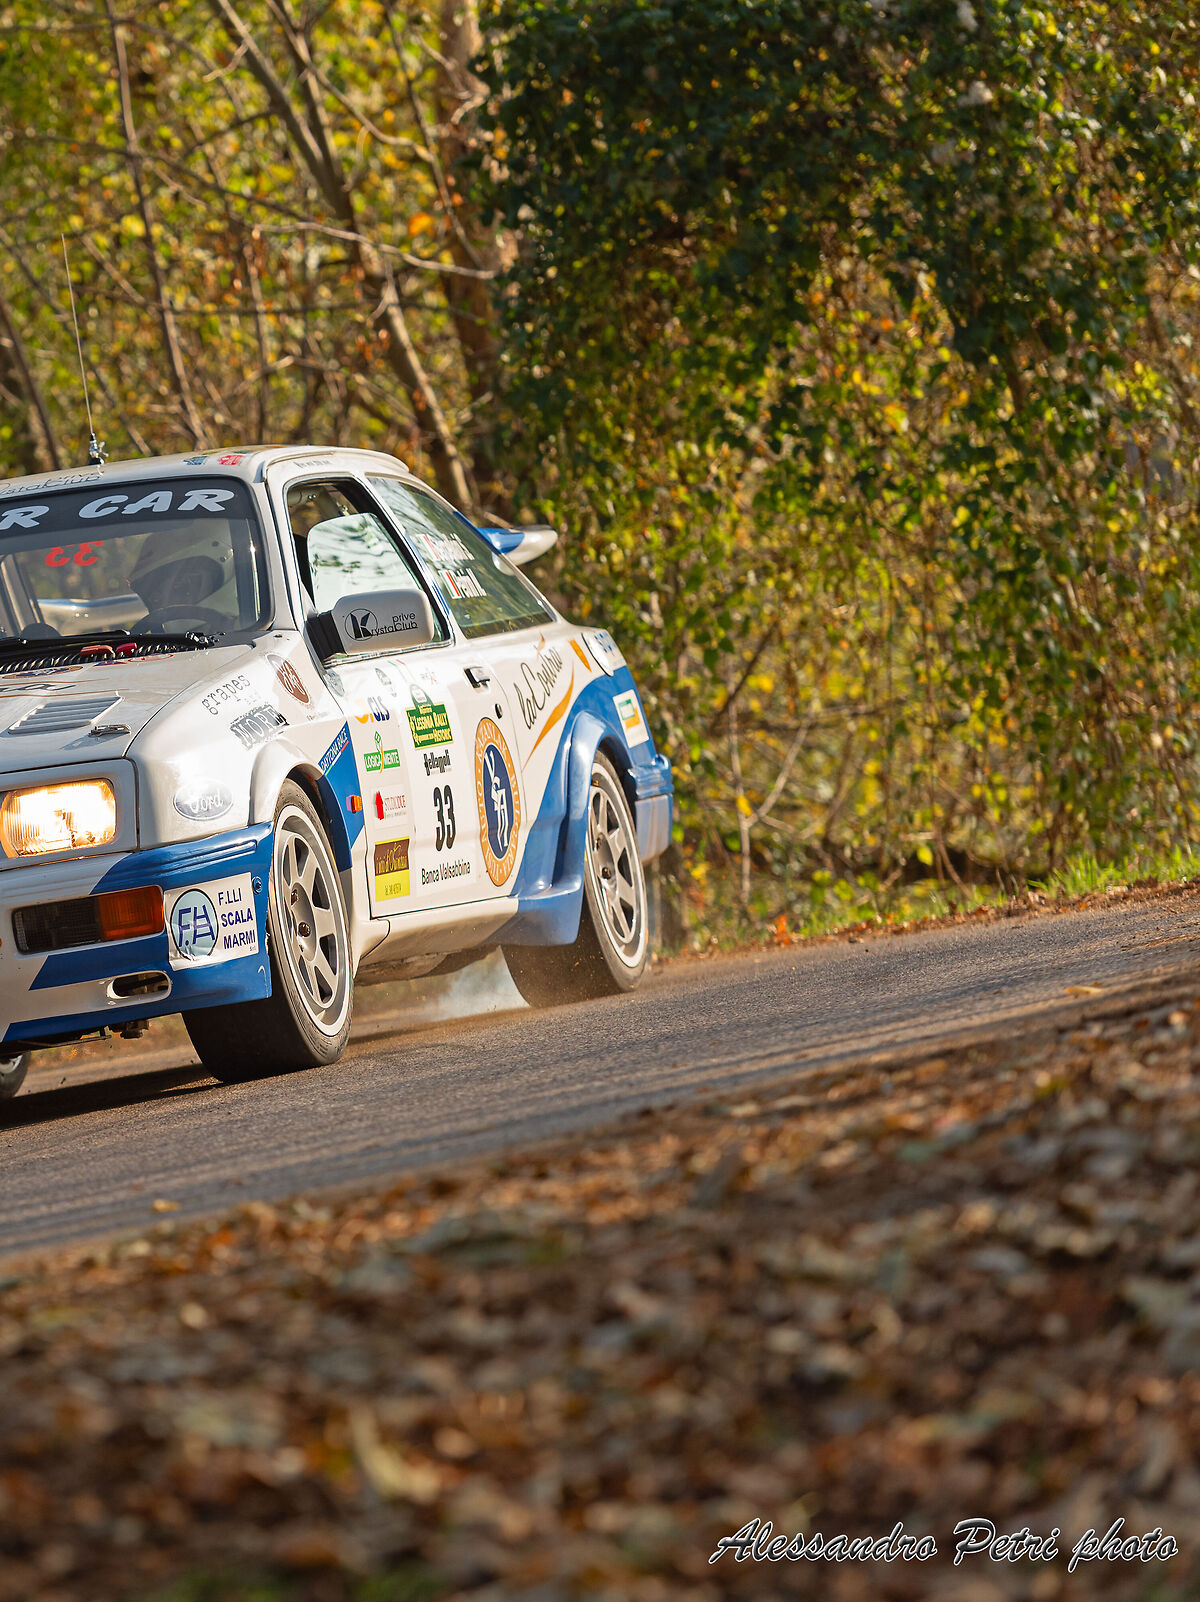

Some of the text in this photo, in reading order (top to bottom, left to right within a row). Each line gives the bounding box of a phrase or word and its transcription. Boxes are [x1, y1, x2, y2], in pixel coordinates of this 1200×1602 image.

[78, 488, 235, 518] CAR
[392, 612, 416, 627] prive
[201, 675, 251, 715] grapes
[233, 706, 287, 745] MORE
[433, 785, 456, 851] 33
[421, 859, 471, 885] Banca Valsabbina
[218, 888, 242, 906] F.LLI
[221, 908, 253, 927] SCALA
[223, 930, 256, 949] MARMI
